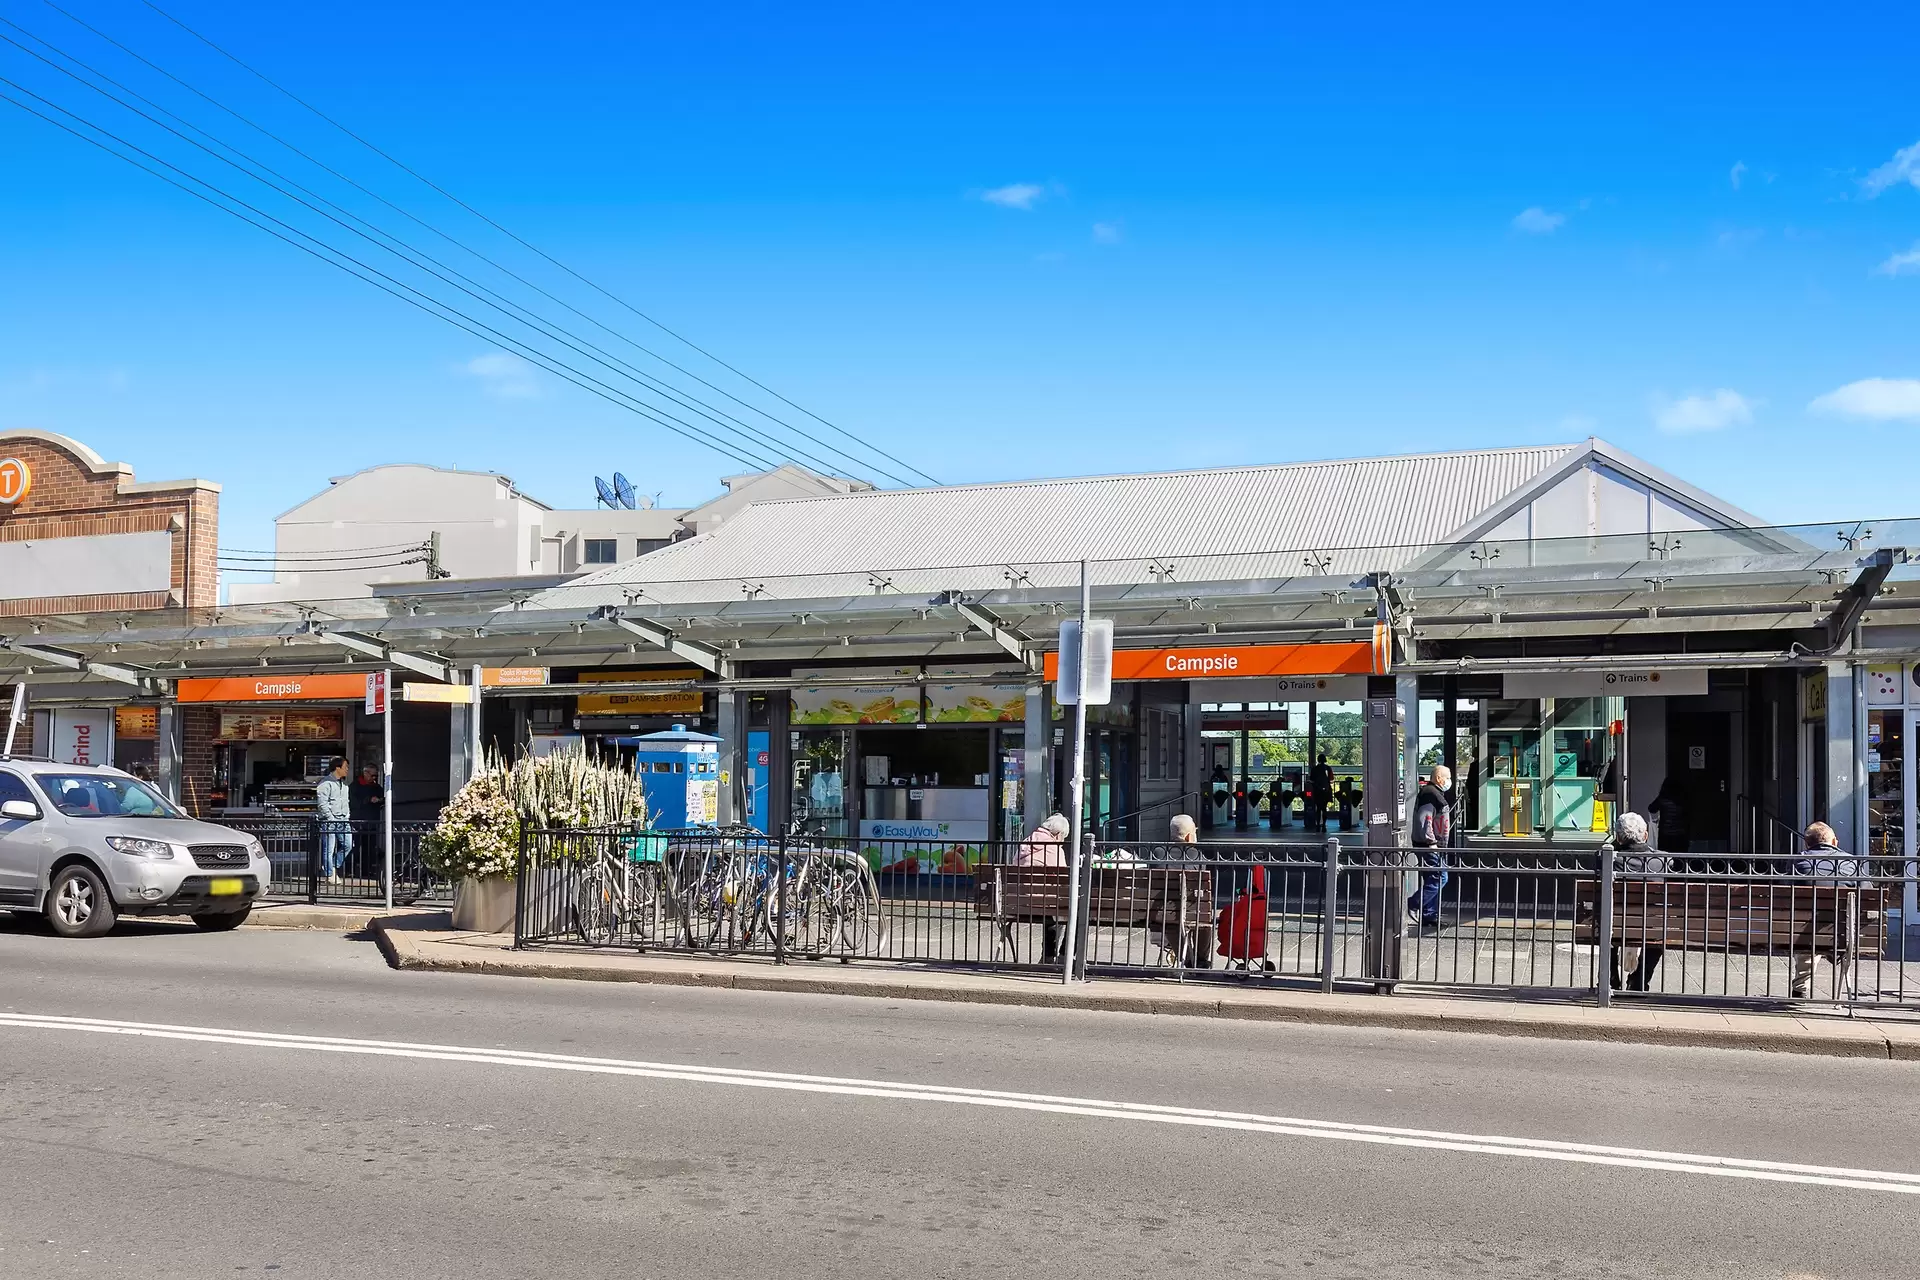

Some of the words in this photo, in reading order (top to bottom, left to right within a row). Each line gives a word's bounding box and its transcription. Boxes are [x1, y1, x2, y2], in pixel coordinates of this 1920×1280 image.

[1, 469, 15, 494] T
[1165, 653, 1238, 674] Campsie
[1290, 680, 1316, 690] Trains
[1619, 673, 1648, 683] Trains
[255, 680, 302, 697] Campsie
[629, 695, 662, 703] CAMPSIE
[663, 693, 695, 702] STATION
[885, 824, 939, 839] EasyWay
